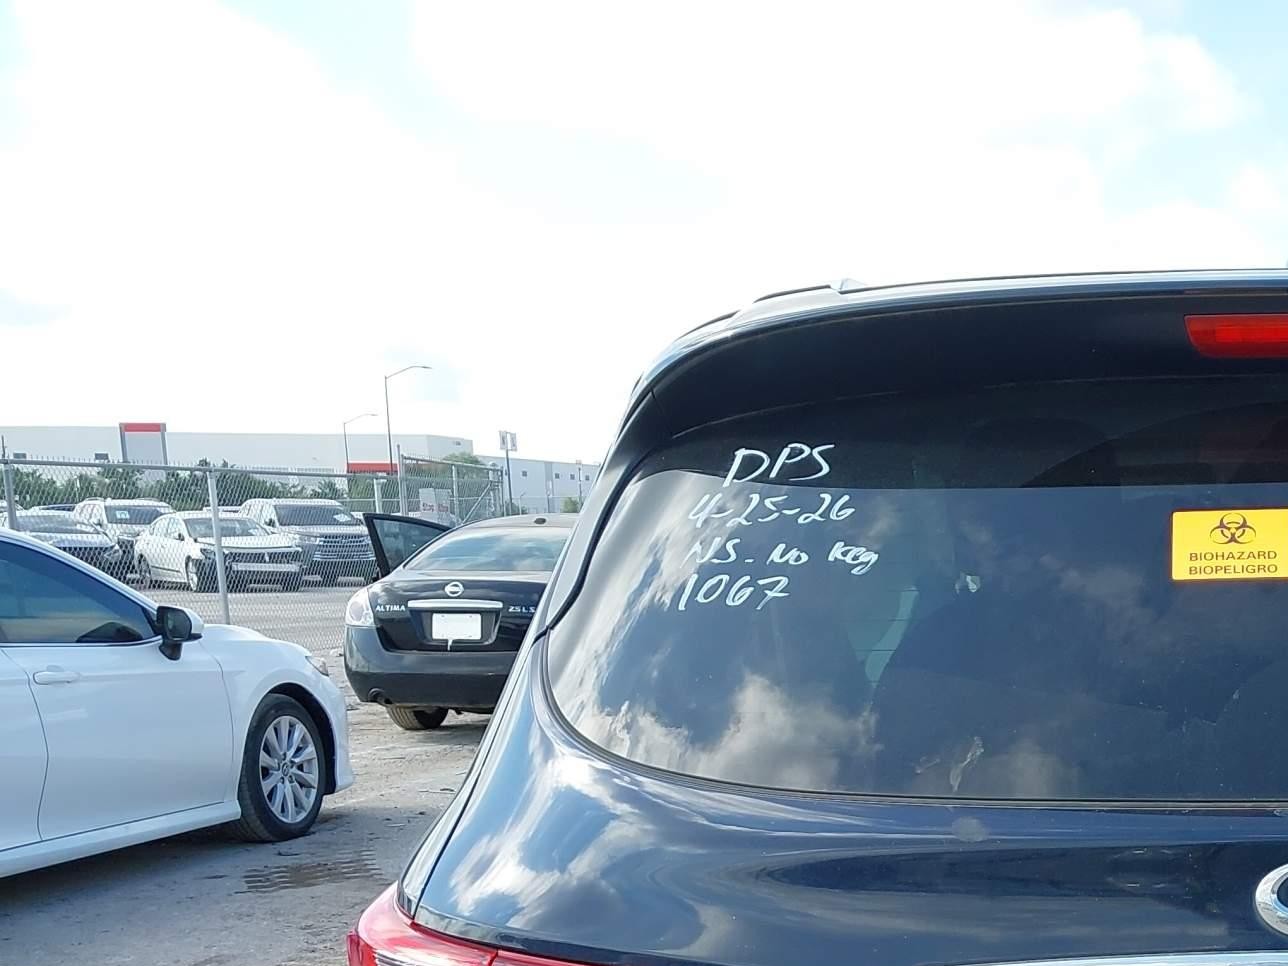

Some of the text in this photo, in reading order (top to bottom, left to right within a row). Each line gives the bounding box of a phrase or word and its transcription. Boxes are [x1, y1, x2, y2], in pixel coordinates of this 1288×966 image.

[722, 443, 835, 488] DPS
[688, 493, 855, 528] 4-25-26
[1189, 550, 1278, 562] BIOHAZARD
[1189, 563, 1278, 576] BIOPELIGRO
[678, 573, 790, 611] 1067
[375, 604, 406, 612] ALTIMA
